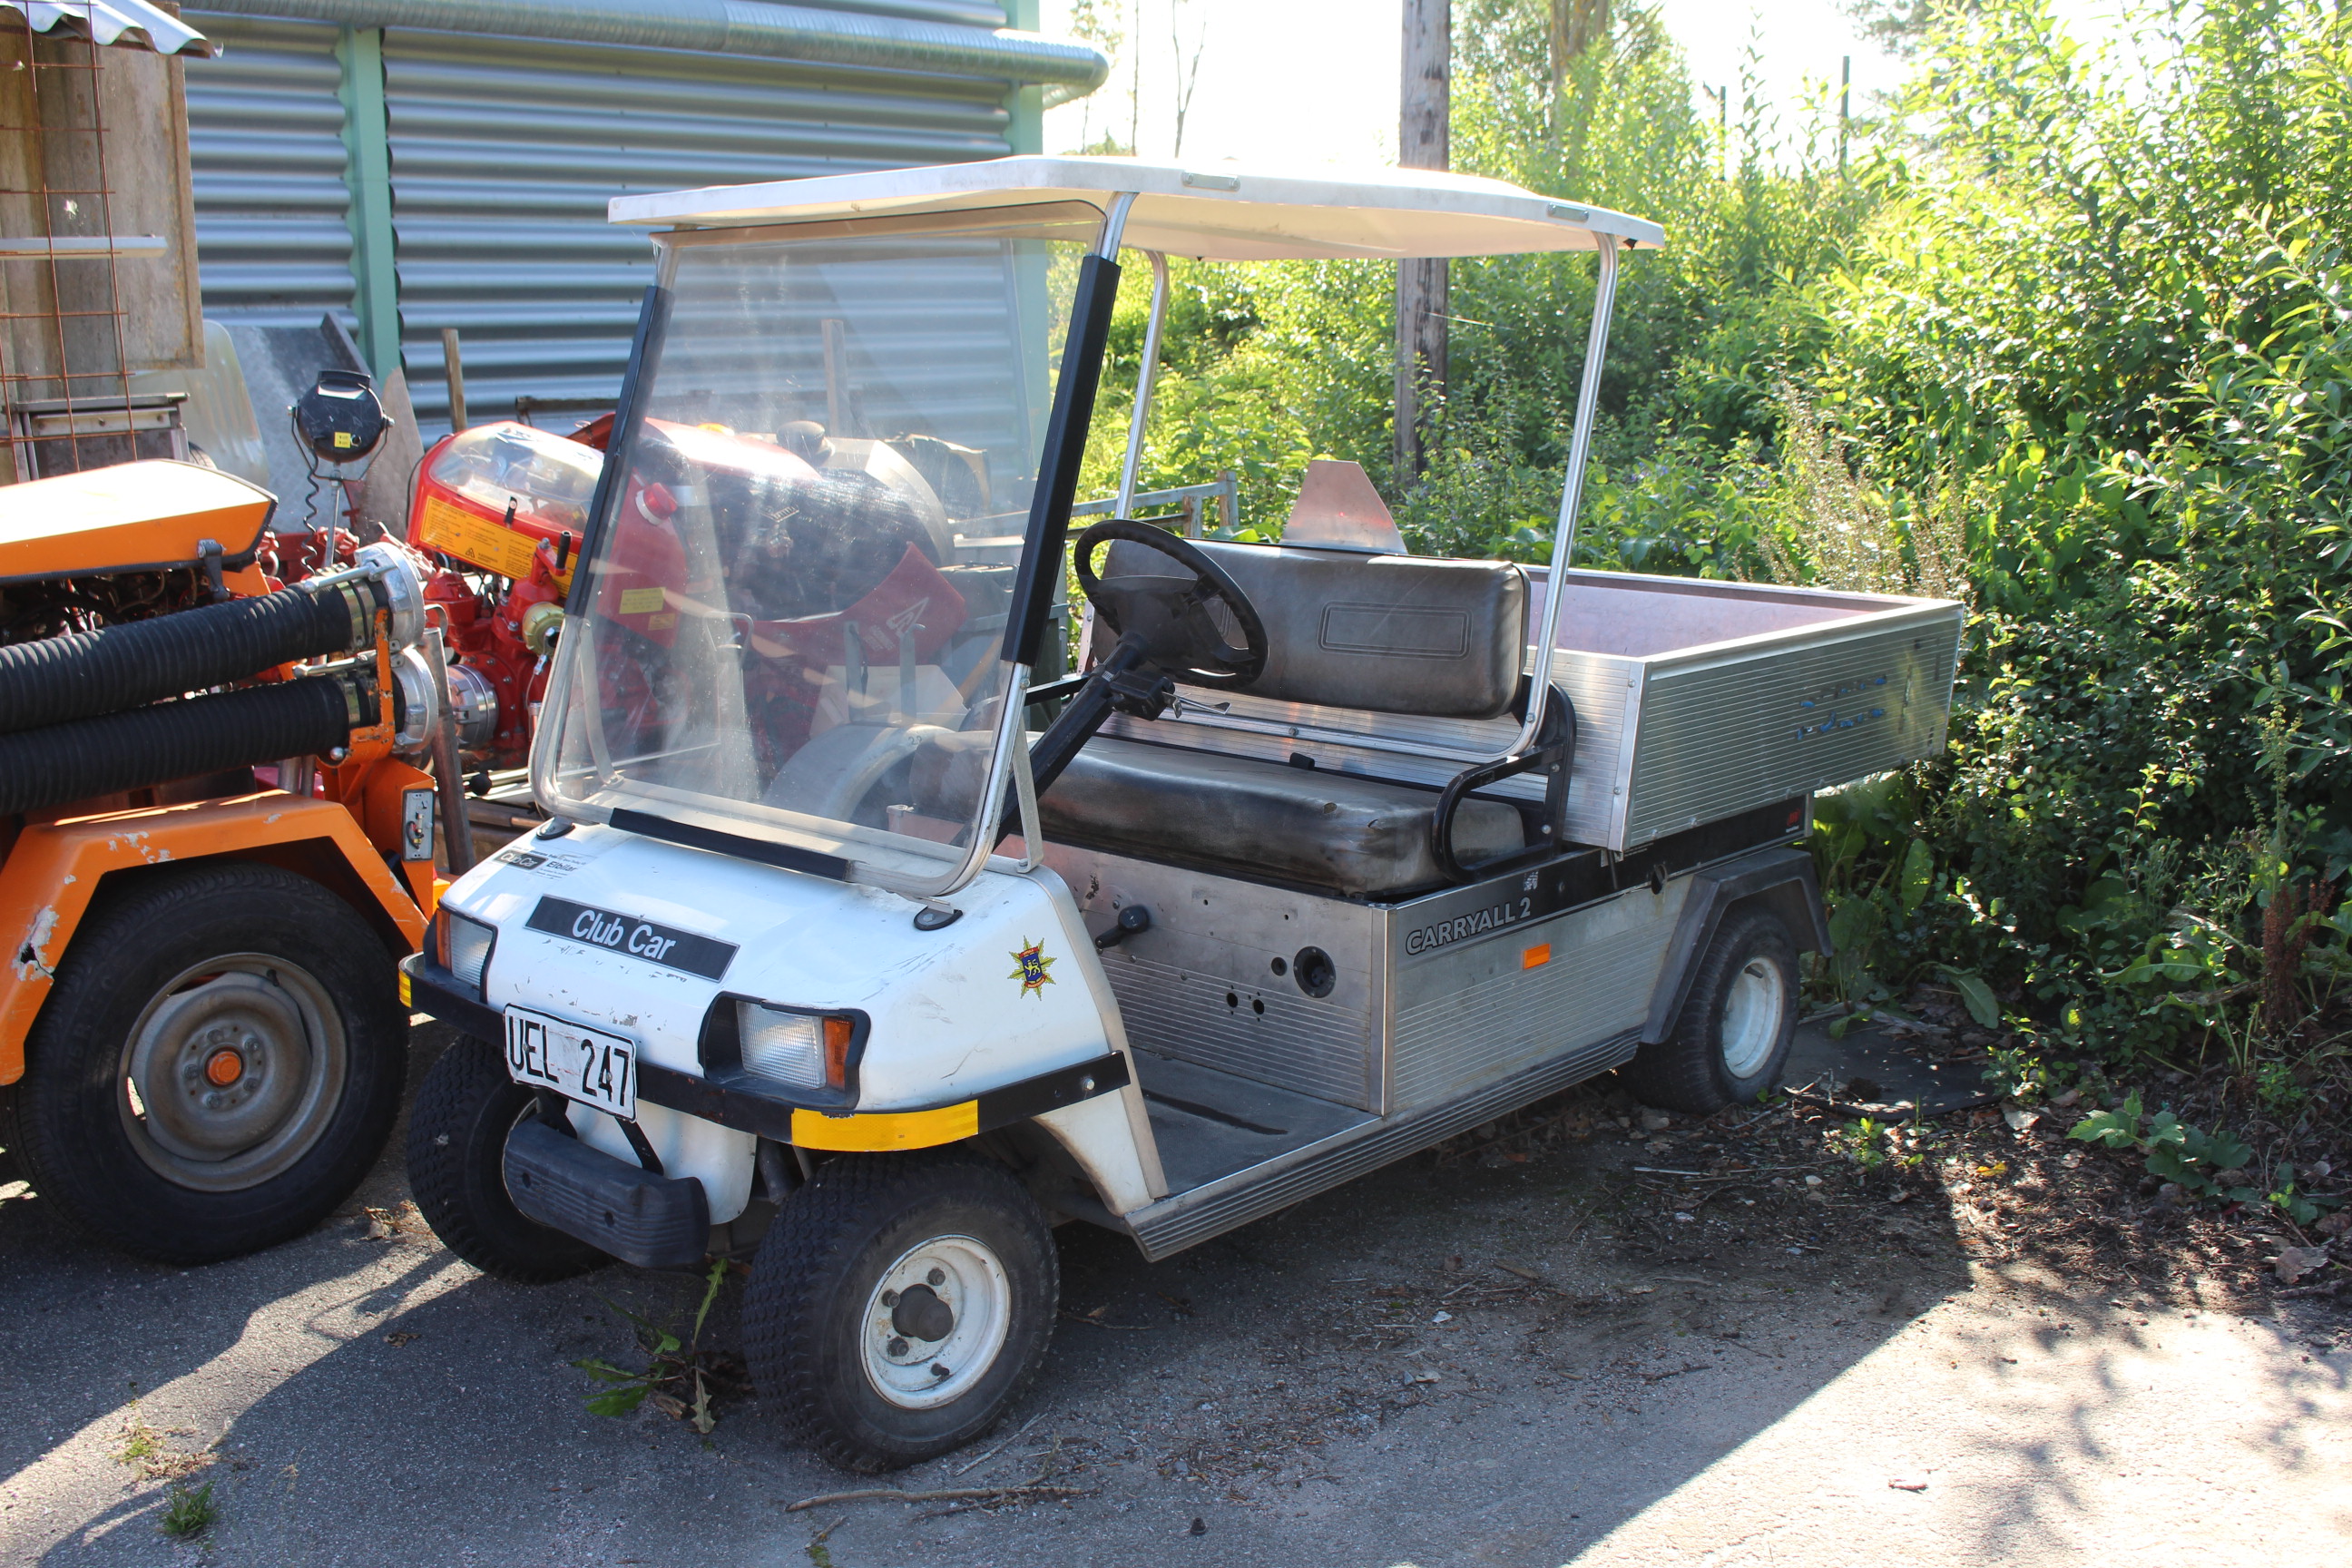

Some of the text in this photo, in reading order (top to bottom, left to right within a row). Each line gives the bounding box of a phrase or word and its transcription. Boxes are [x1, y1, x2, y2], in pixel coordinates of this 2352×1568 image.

[500, 852, 537, 867] Club Car
[546, 860, 578, 872] Elbilar
[572, 909, 676, 960] Club Car
[1406, 897, 1531, 956] CARRYALL 2
[508, 1015, 629, 1107] UEL 247
